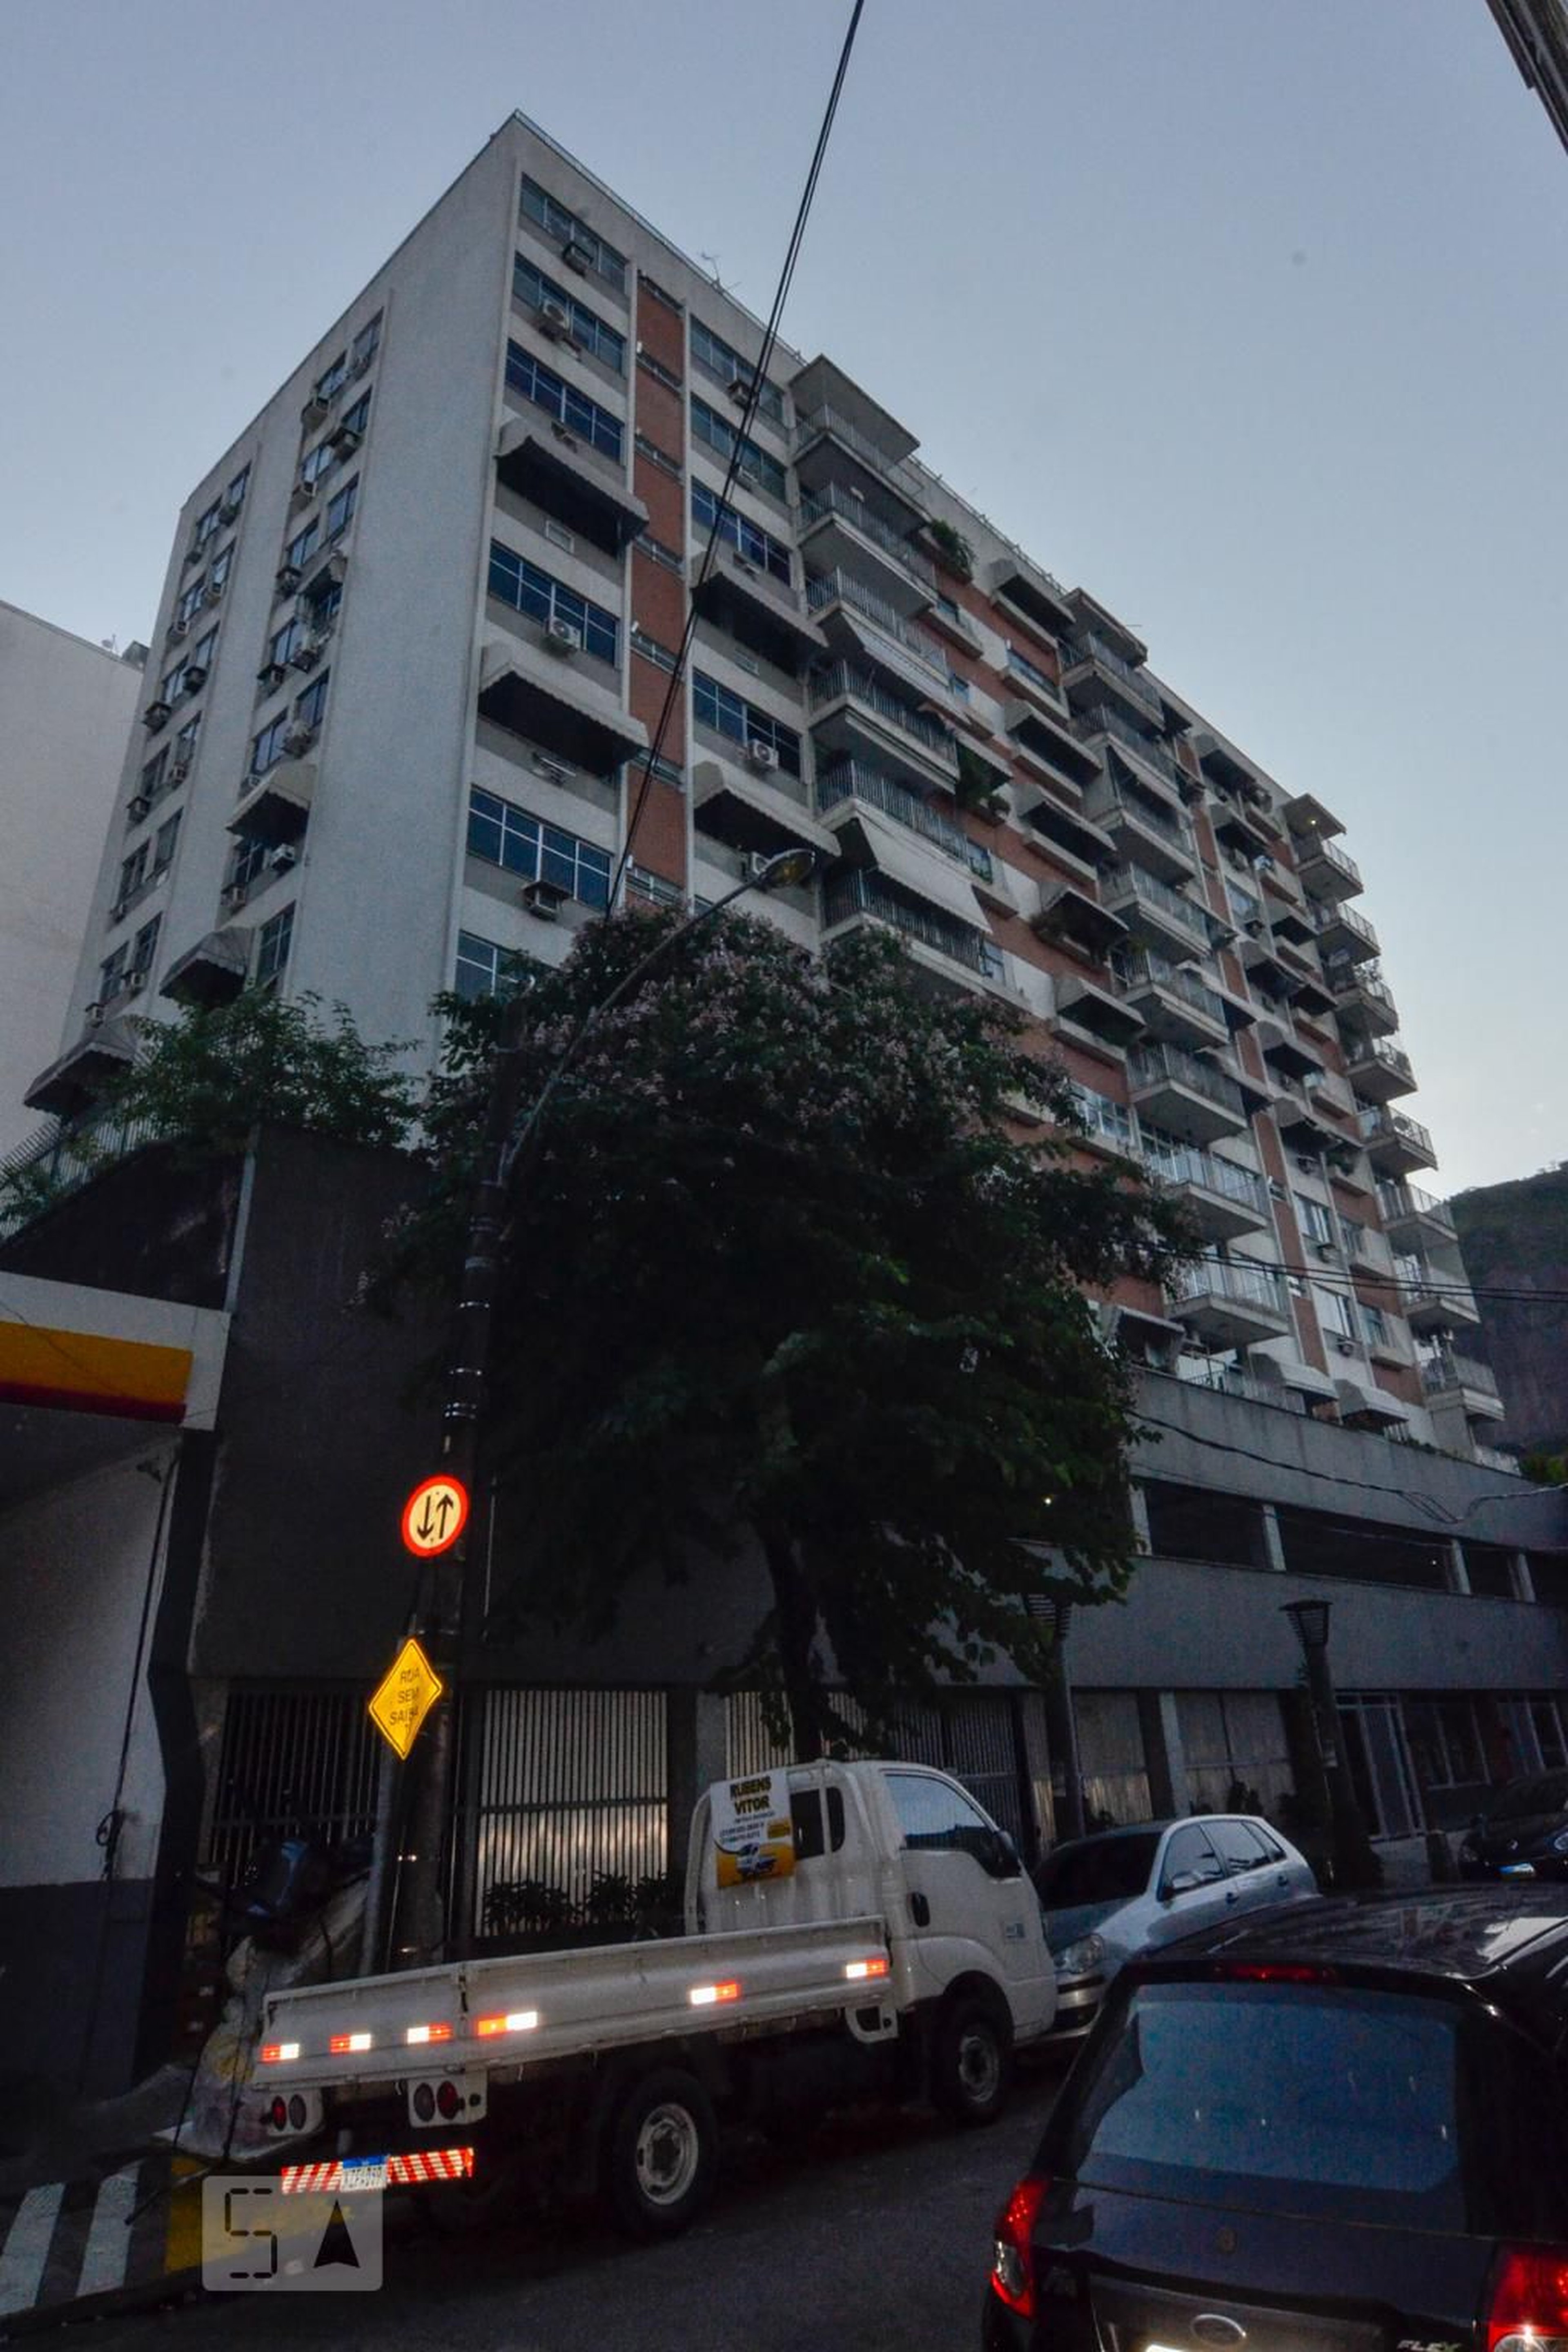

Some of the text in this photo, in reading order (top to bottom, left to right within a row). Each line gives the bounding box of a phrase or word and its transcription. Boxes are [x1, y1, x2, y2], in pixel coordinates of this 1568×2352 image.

[400, 1667, 420, 1684] RUA
[397, 1686, 419, 1704] SEM
[730, 1776, 771, 1800] RUBENS
[735, 1795, 769, 1815] VITOR
